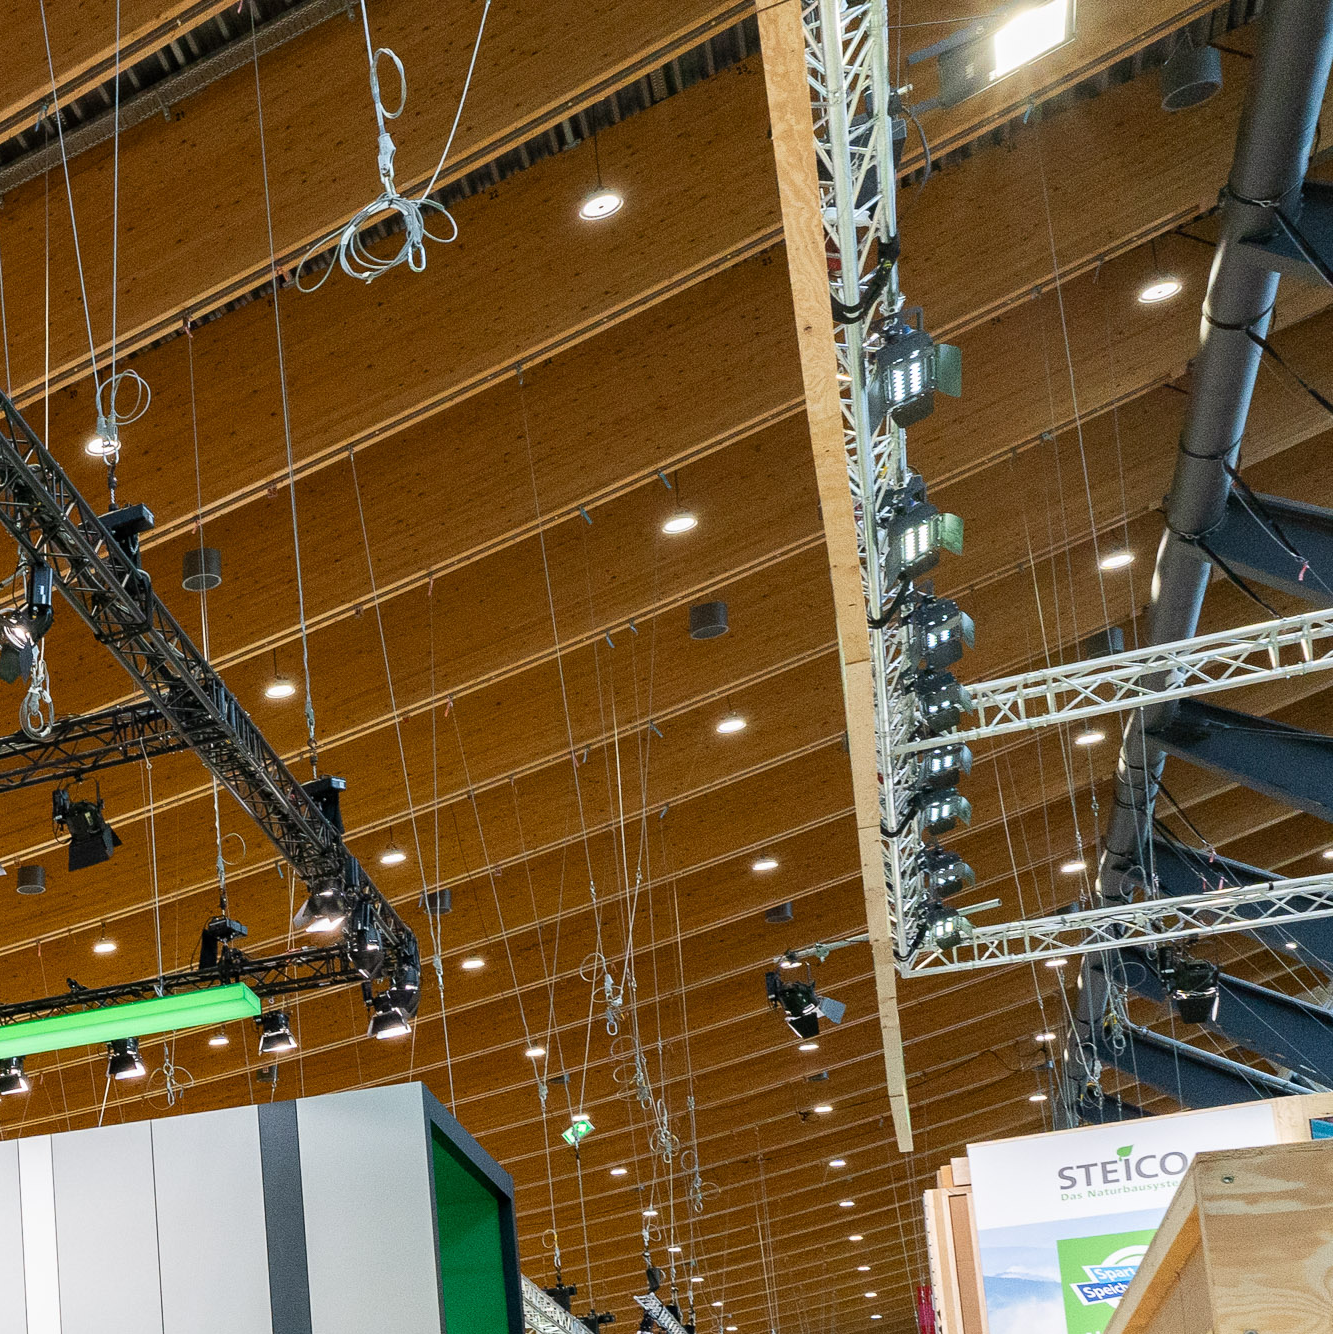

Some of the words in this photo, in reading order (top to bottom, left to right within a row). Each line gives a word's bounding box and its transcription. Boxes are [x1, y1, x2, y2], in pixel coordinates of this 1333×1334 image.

[1058, 1151, 1188, 1189] STEICO
[1061, 1192, 1082, 1201] Das
[1088, 1180, 1179, 1198] Naturbausyste
[1084, 1283, 1130, 1299] Speich
